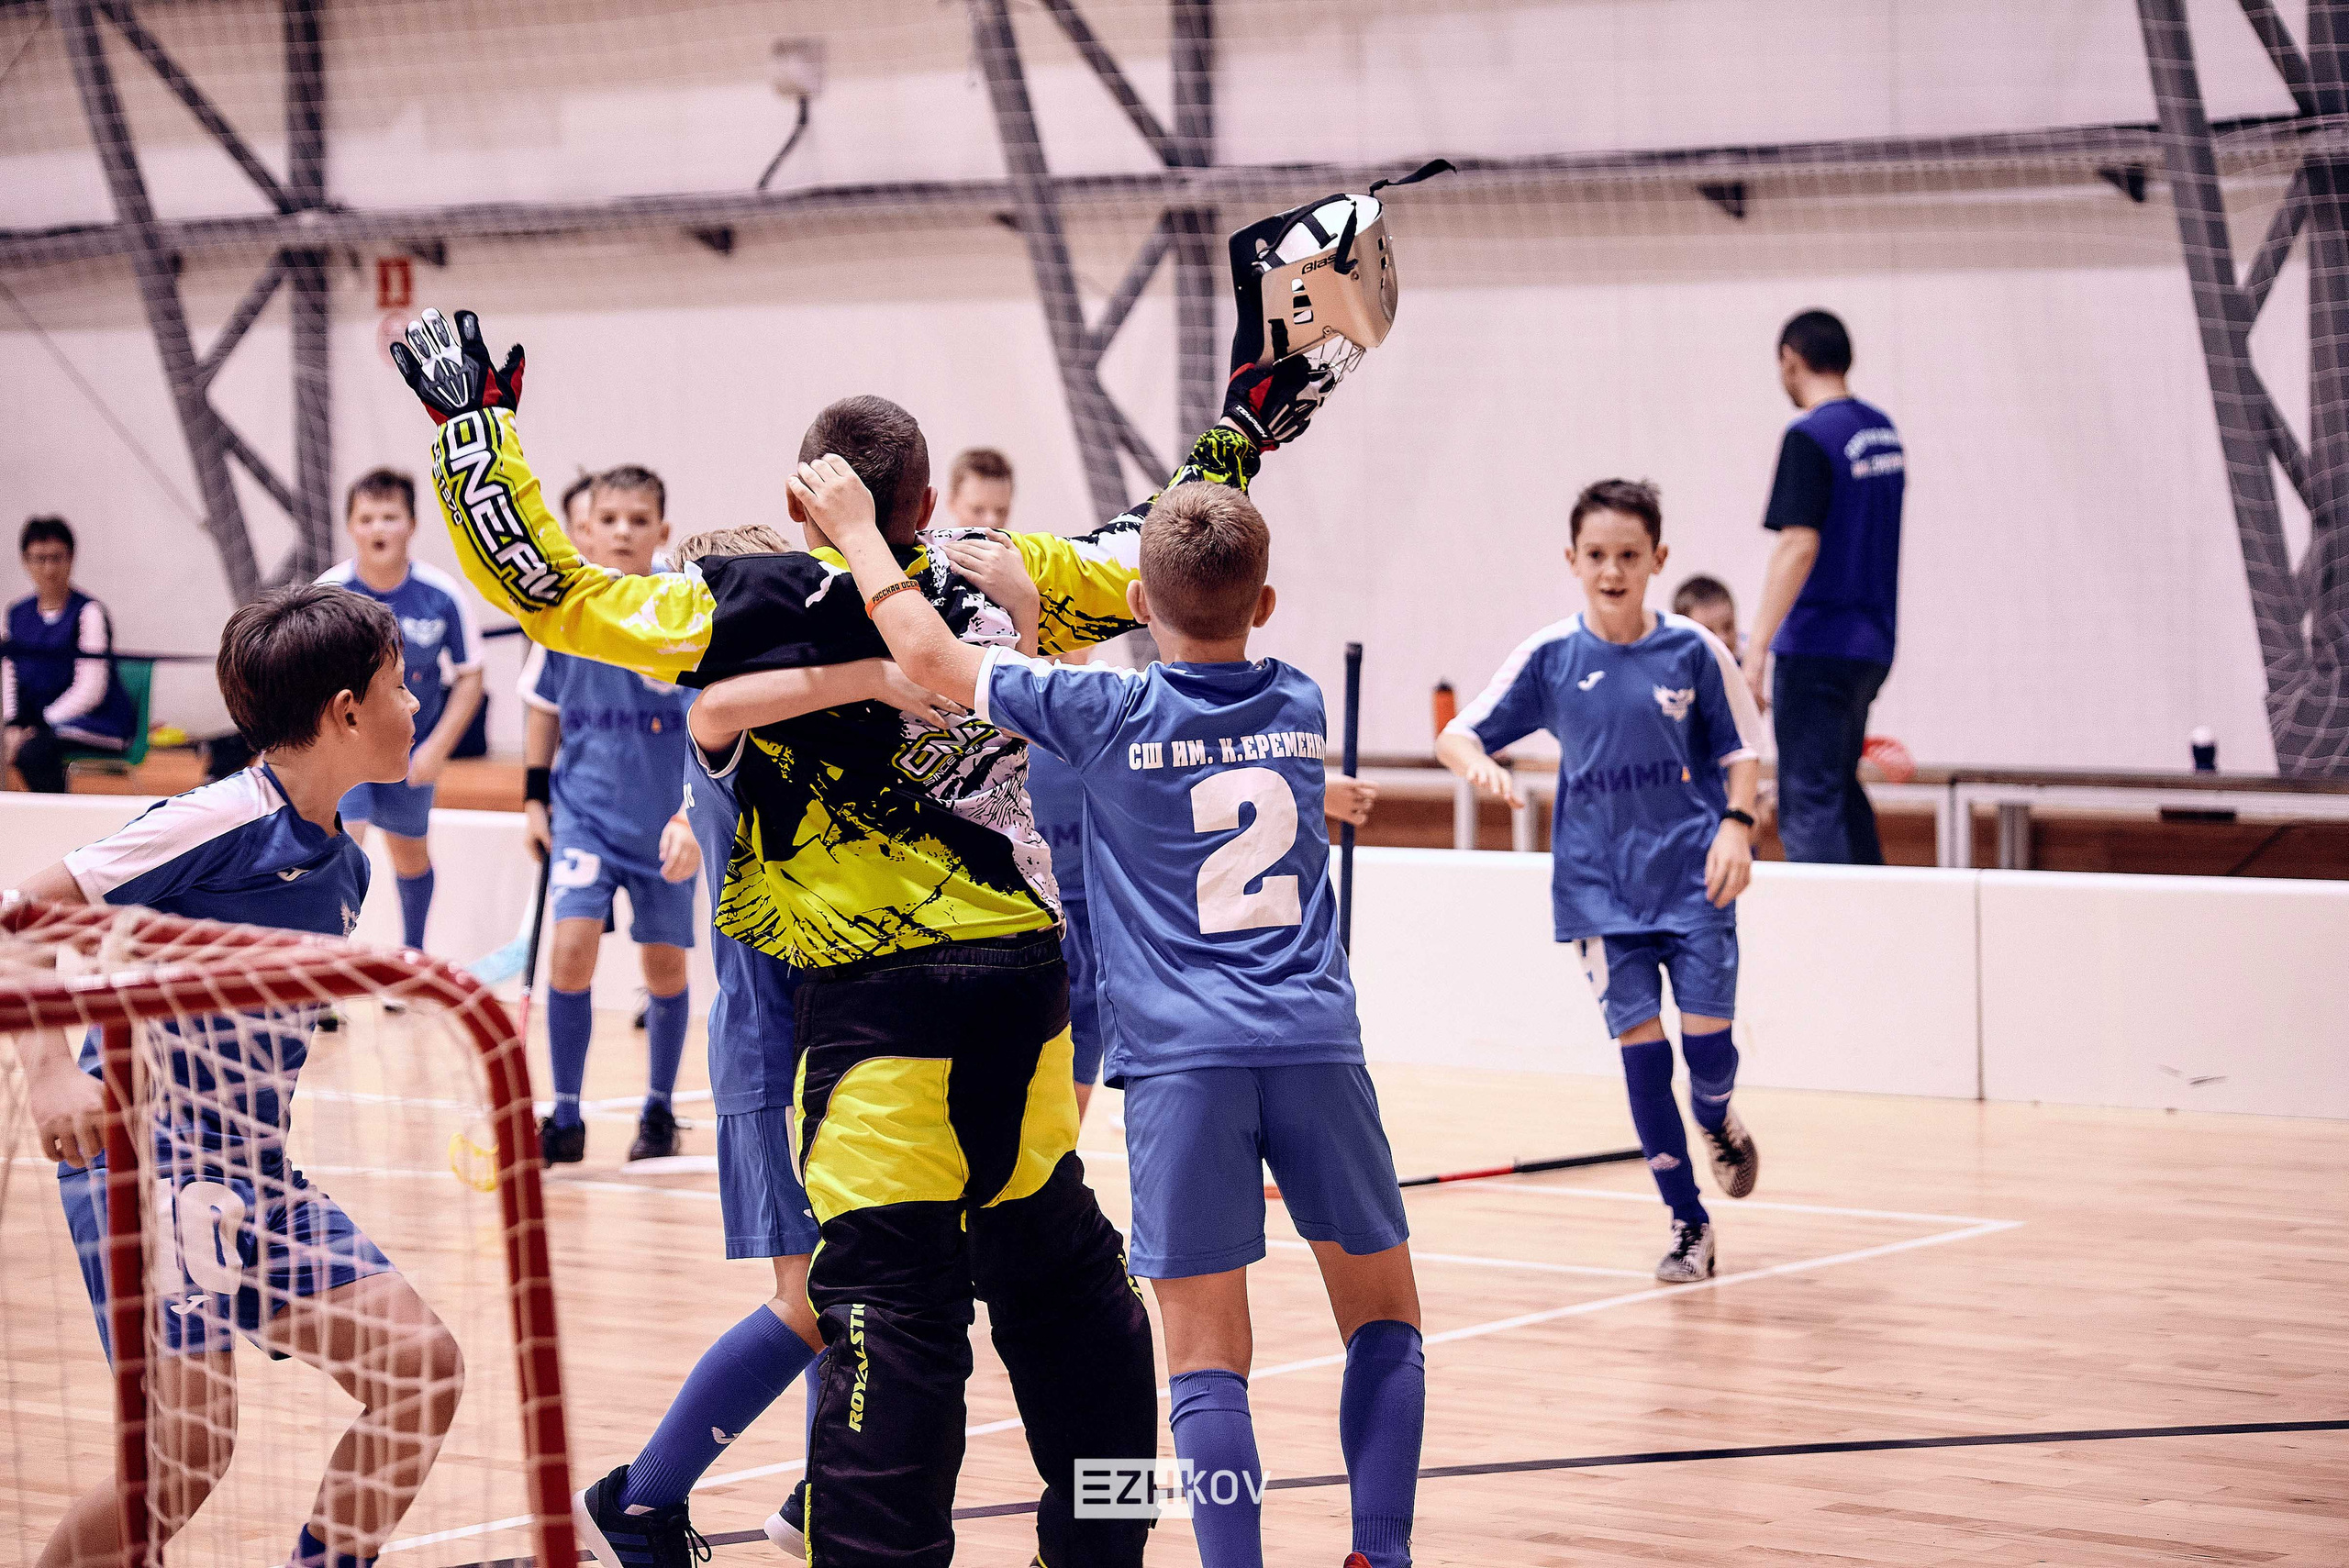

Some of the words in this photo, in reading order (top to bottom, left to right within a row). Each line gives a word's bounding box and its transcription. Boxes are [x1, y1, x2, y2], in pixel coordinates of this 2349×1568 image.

[872, 583, 901, 604] РУССКАЯ
[1129, 742, 1163, 770] СШ
[1172, 740, 1213, 767] ИМ.
[923, 756, 957, 787] SINCE
[1190, 766, 1303, 935] 2
